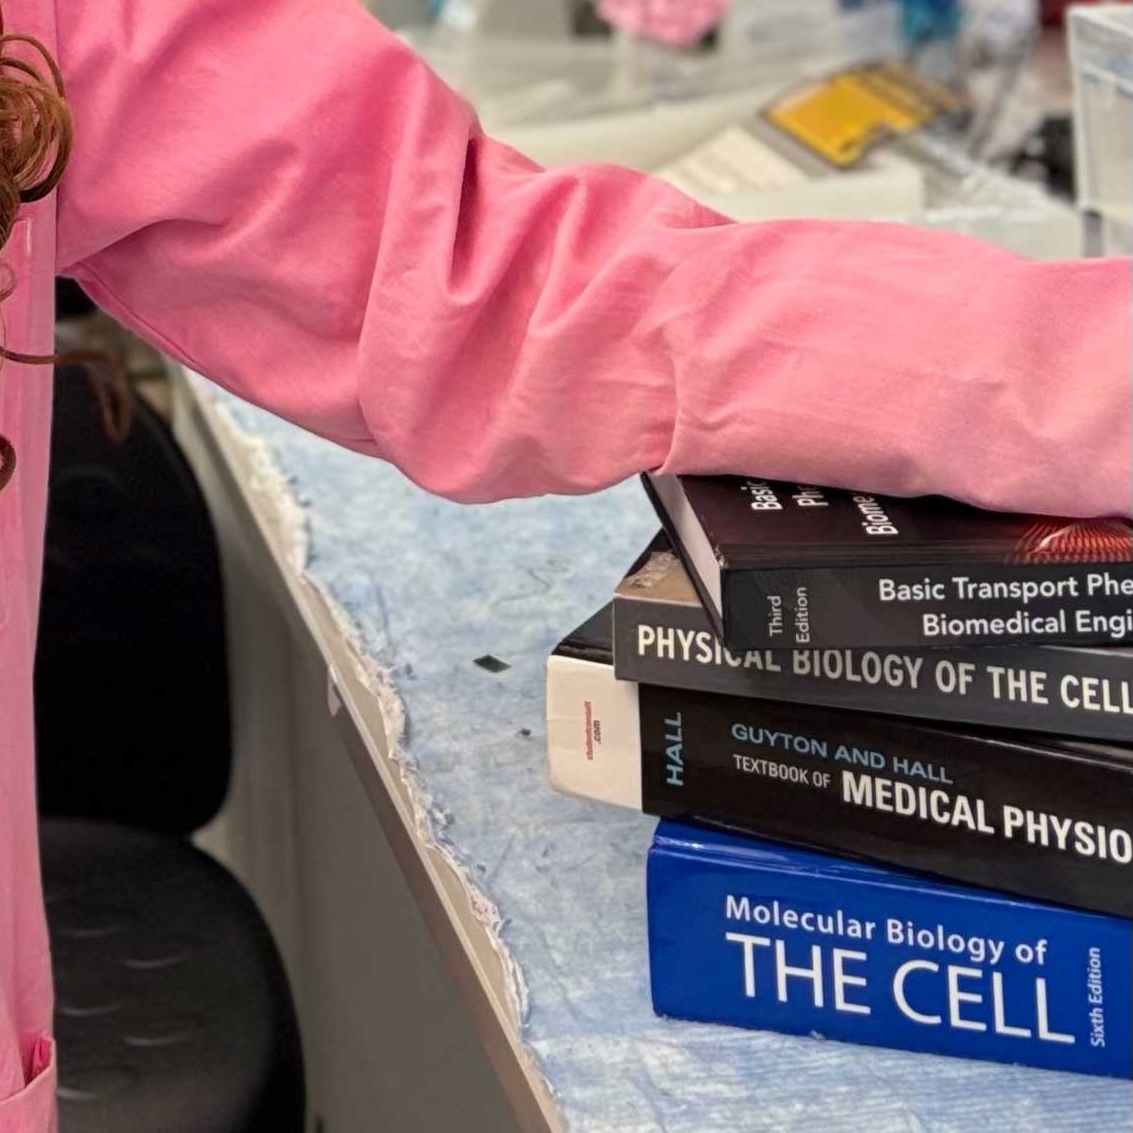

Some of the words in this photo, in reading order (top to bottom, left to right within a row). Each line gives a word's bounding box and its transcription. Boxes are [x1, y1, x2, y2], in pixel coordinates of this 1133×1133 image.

[767, 595, 782, 636] Third
[794, 586, 811, 643] Edition
[878, 577, 945, 601] Basic
[952, 575, 1079, 604] Transport
[1086, 572, 1133, 596] Phe
[923, 609, 1067, 636] Biomedical
[1075, 608, 1133, 639] Engi
[792, 649, 923, 689] BIOLOGY
[935, 659, 975, 695] OF
[986, 665, 1049, 704] THE
[1060, 674, 1133, 715] CELL
[593, 719, 602, 745] .com
[664, 712, 684, 786] HALL
[731, 723, 827, 758] GUYTON
[834, 745, 886, 769] AND
[893, 756, 954, 785] HALL
[733, 754, 810, 785] TEXTBOOK
[812, 771, 832, 789] OF
[842, 769, 995, 835] MEDICAL
[1003, 804, 1133, 865] PHYSIO
[725, 894, 876, 940] Molecular
[886, 918, 1004, 965] Biology
[1015, 938, 1048, 965] of
[725, 931, 871, 1015] THE
[893, 959, 1076, 1045] CELL
[1087, 947, 1103, 1004] Edition
[1089, 1007, 1105, 1048] Sixth
